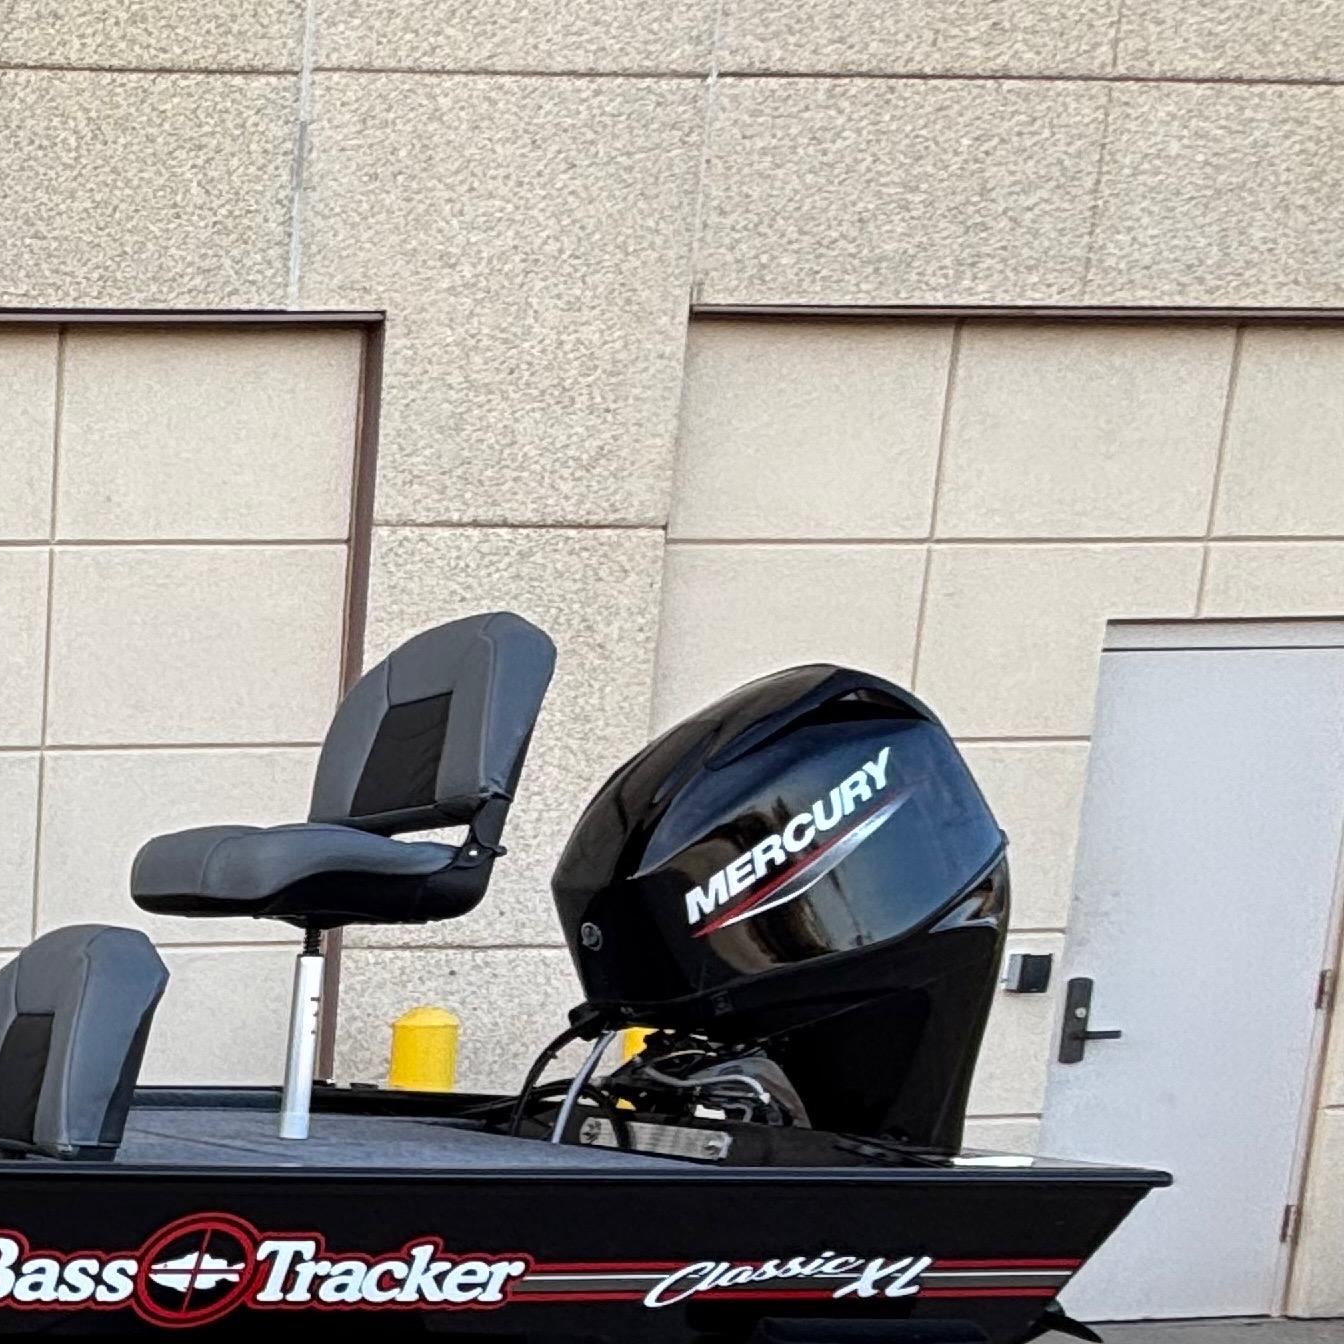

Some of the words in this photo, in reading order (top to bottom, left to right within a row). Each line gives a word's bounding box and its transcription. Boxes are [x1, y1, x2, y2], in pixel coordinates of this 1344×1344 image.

[684, 746, 891, 926] MERCURY
[255, 1240, 525, 1303] Tracker
[643, 1251, 865, 1308] Classic
[832, 1256, 934, 1299] XL
